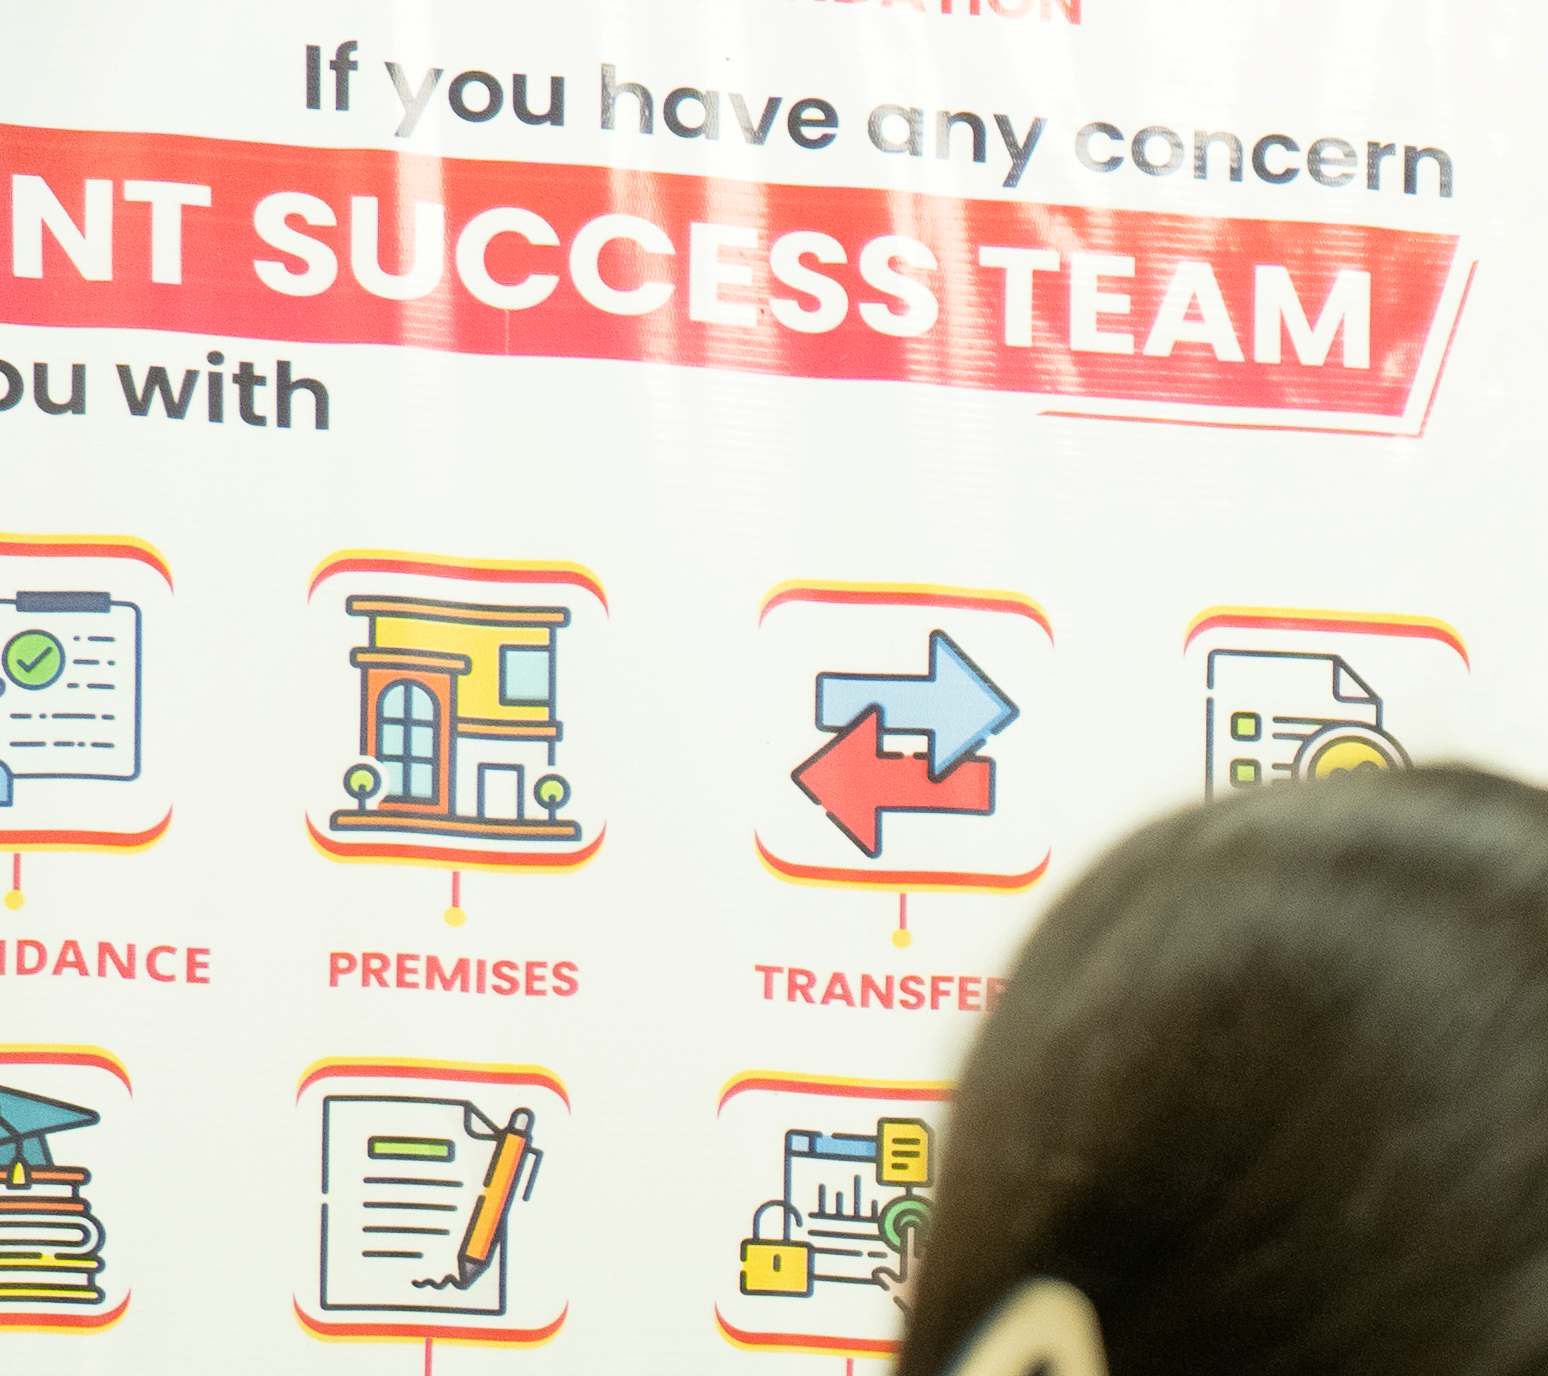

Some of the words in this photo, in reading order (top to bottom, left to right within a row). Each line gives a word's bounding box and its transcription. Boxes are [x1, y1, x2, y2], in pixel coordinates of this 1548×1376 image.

[306, 40, 358, 111] If
[384, 62, 565, 137] you
[601, 64, 839, 150] have
[868, 103, 1046, 187] any
[1075, 119, 1454, 197] concern
[12, 174, 212, 284] NT
[252, 190, 940, 337] SUCCESS
[979, 246, 1371, 369] TEAM
[115, 351, 330, 430] with
[329, 952, 579, 997] PREMISES
